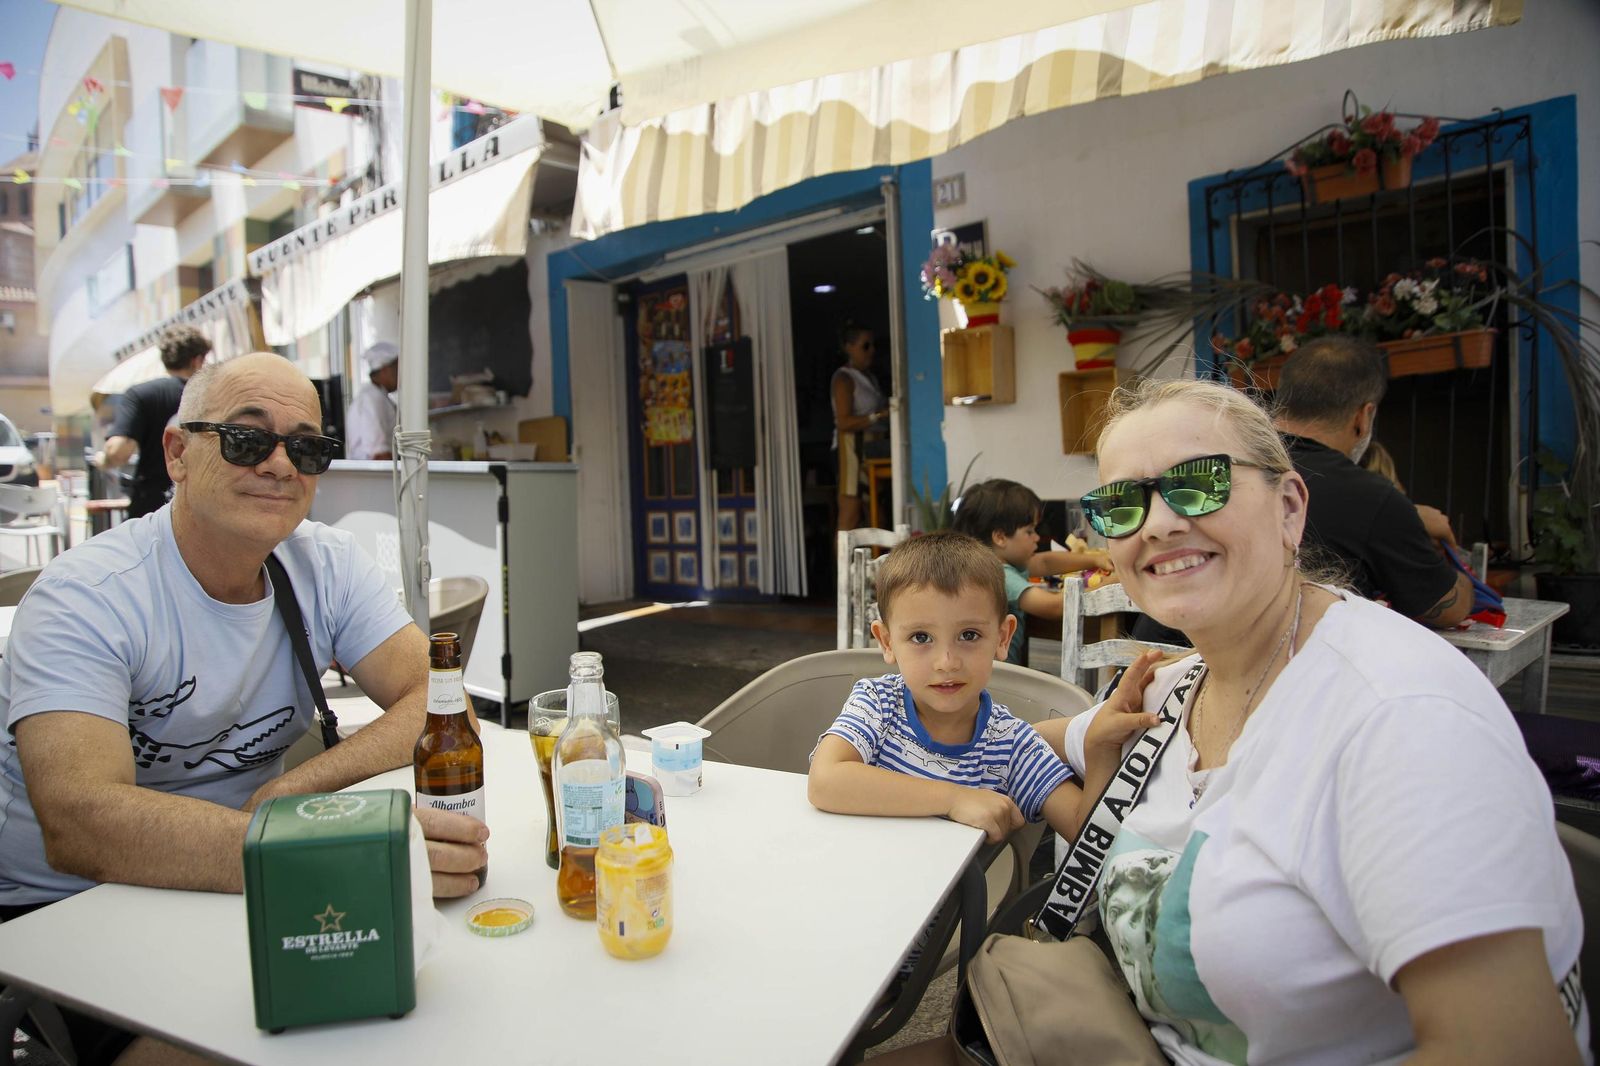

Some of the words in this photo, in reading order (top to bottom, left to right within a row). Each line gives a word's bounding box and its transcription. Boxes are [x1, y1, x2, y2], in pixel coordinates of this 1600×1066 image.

[349, 135, 500, 225] PARLLA
[430, 798, 477, 811] Alhambra
[281, 928, 380, 950] ESTRELLA
